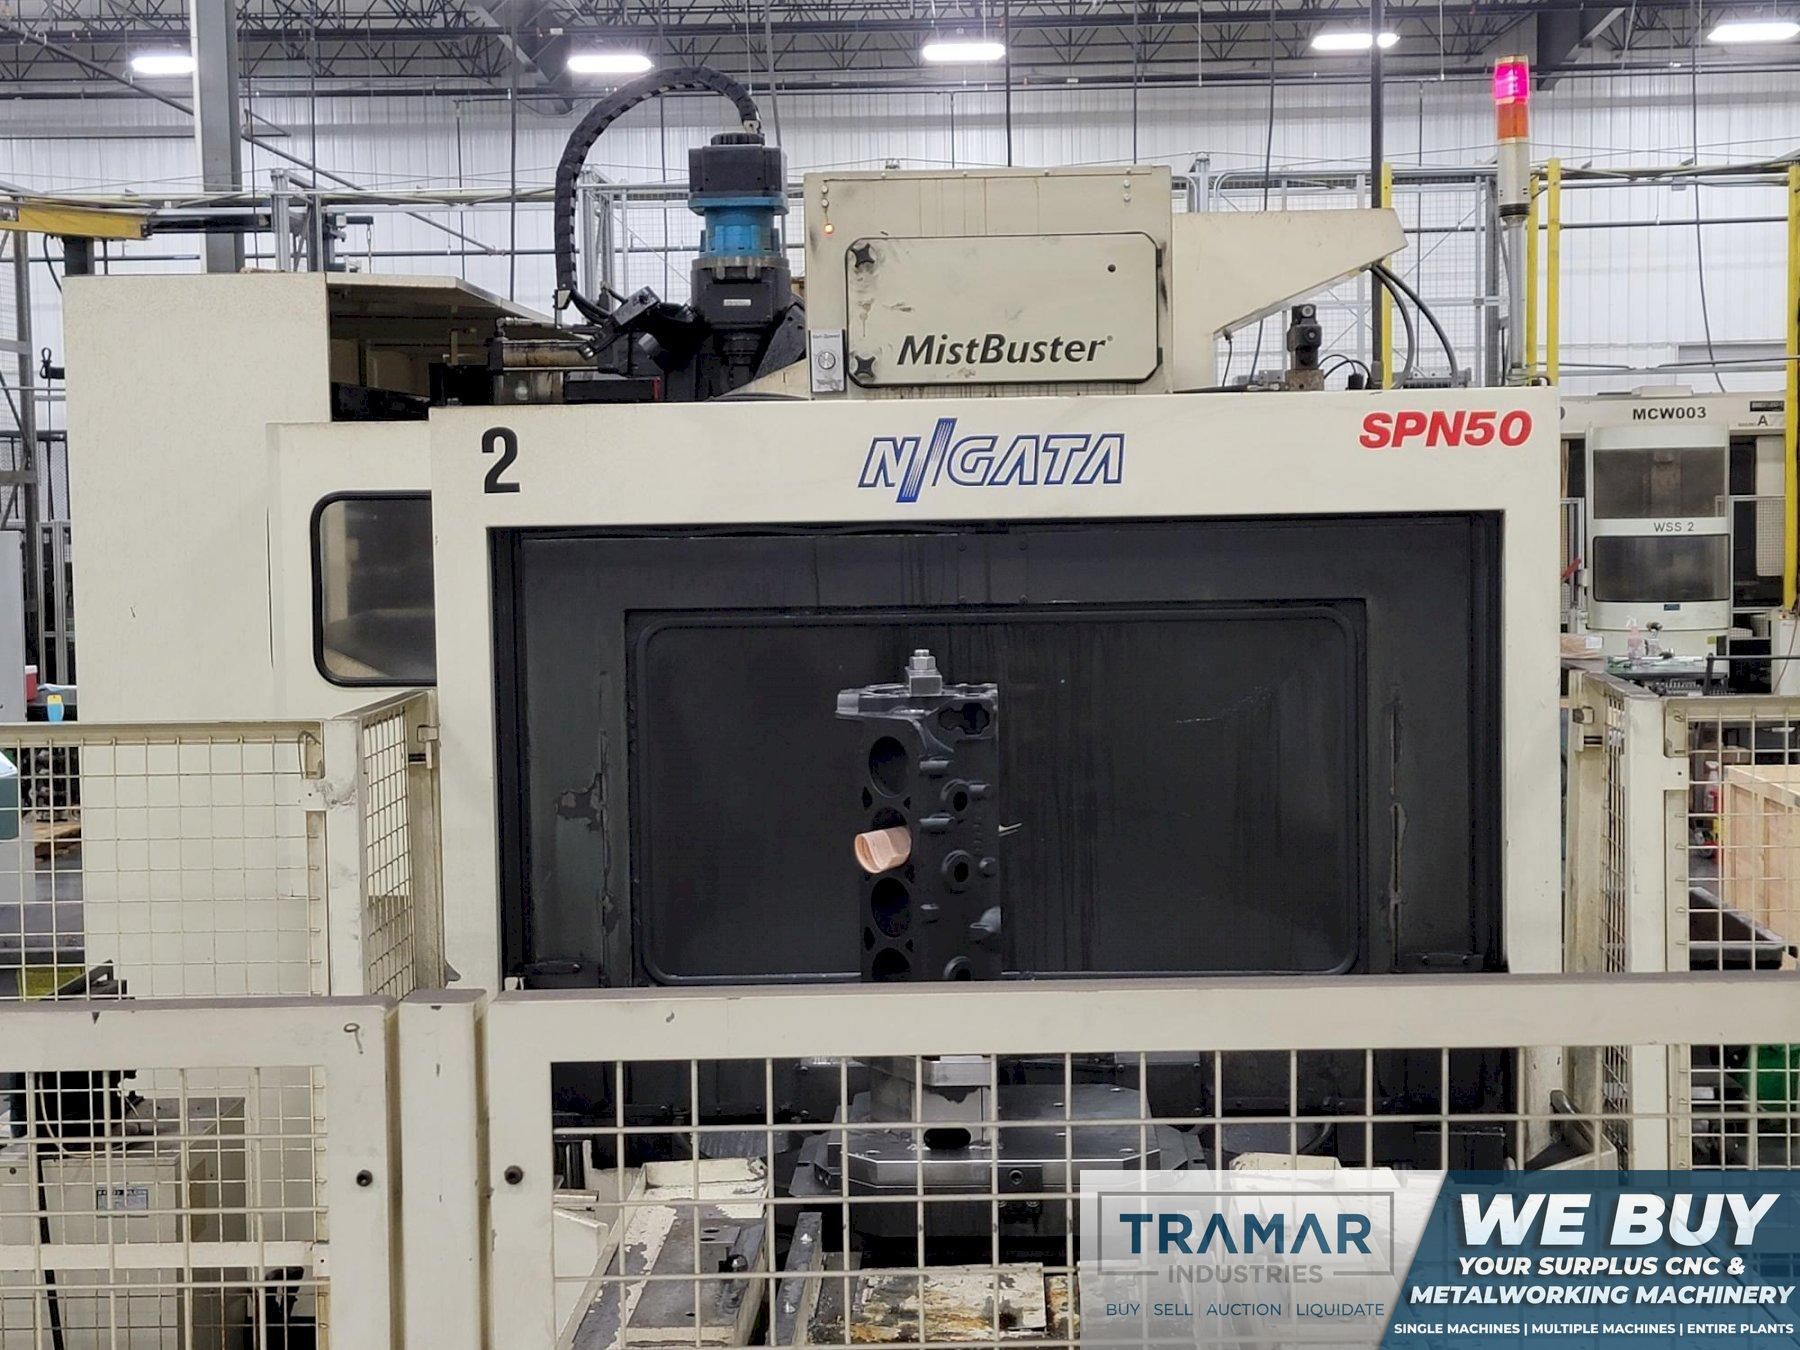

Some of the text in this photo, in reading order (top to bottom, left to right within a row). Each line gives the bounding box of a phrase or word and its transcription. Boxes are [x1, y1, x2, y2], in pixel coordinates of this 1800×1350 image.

[1633, 407, 1706, 420] MCW003
[1757, 415, 1768, 426] A
[1359, 410, 1532, 448] SPN50
[481, 426, 521, 494] 2
[1653, 522, 1695, 532] WSS 2
